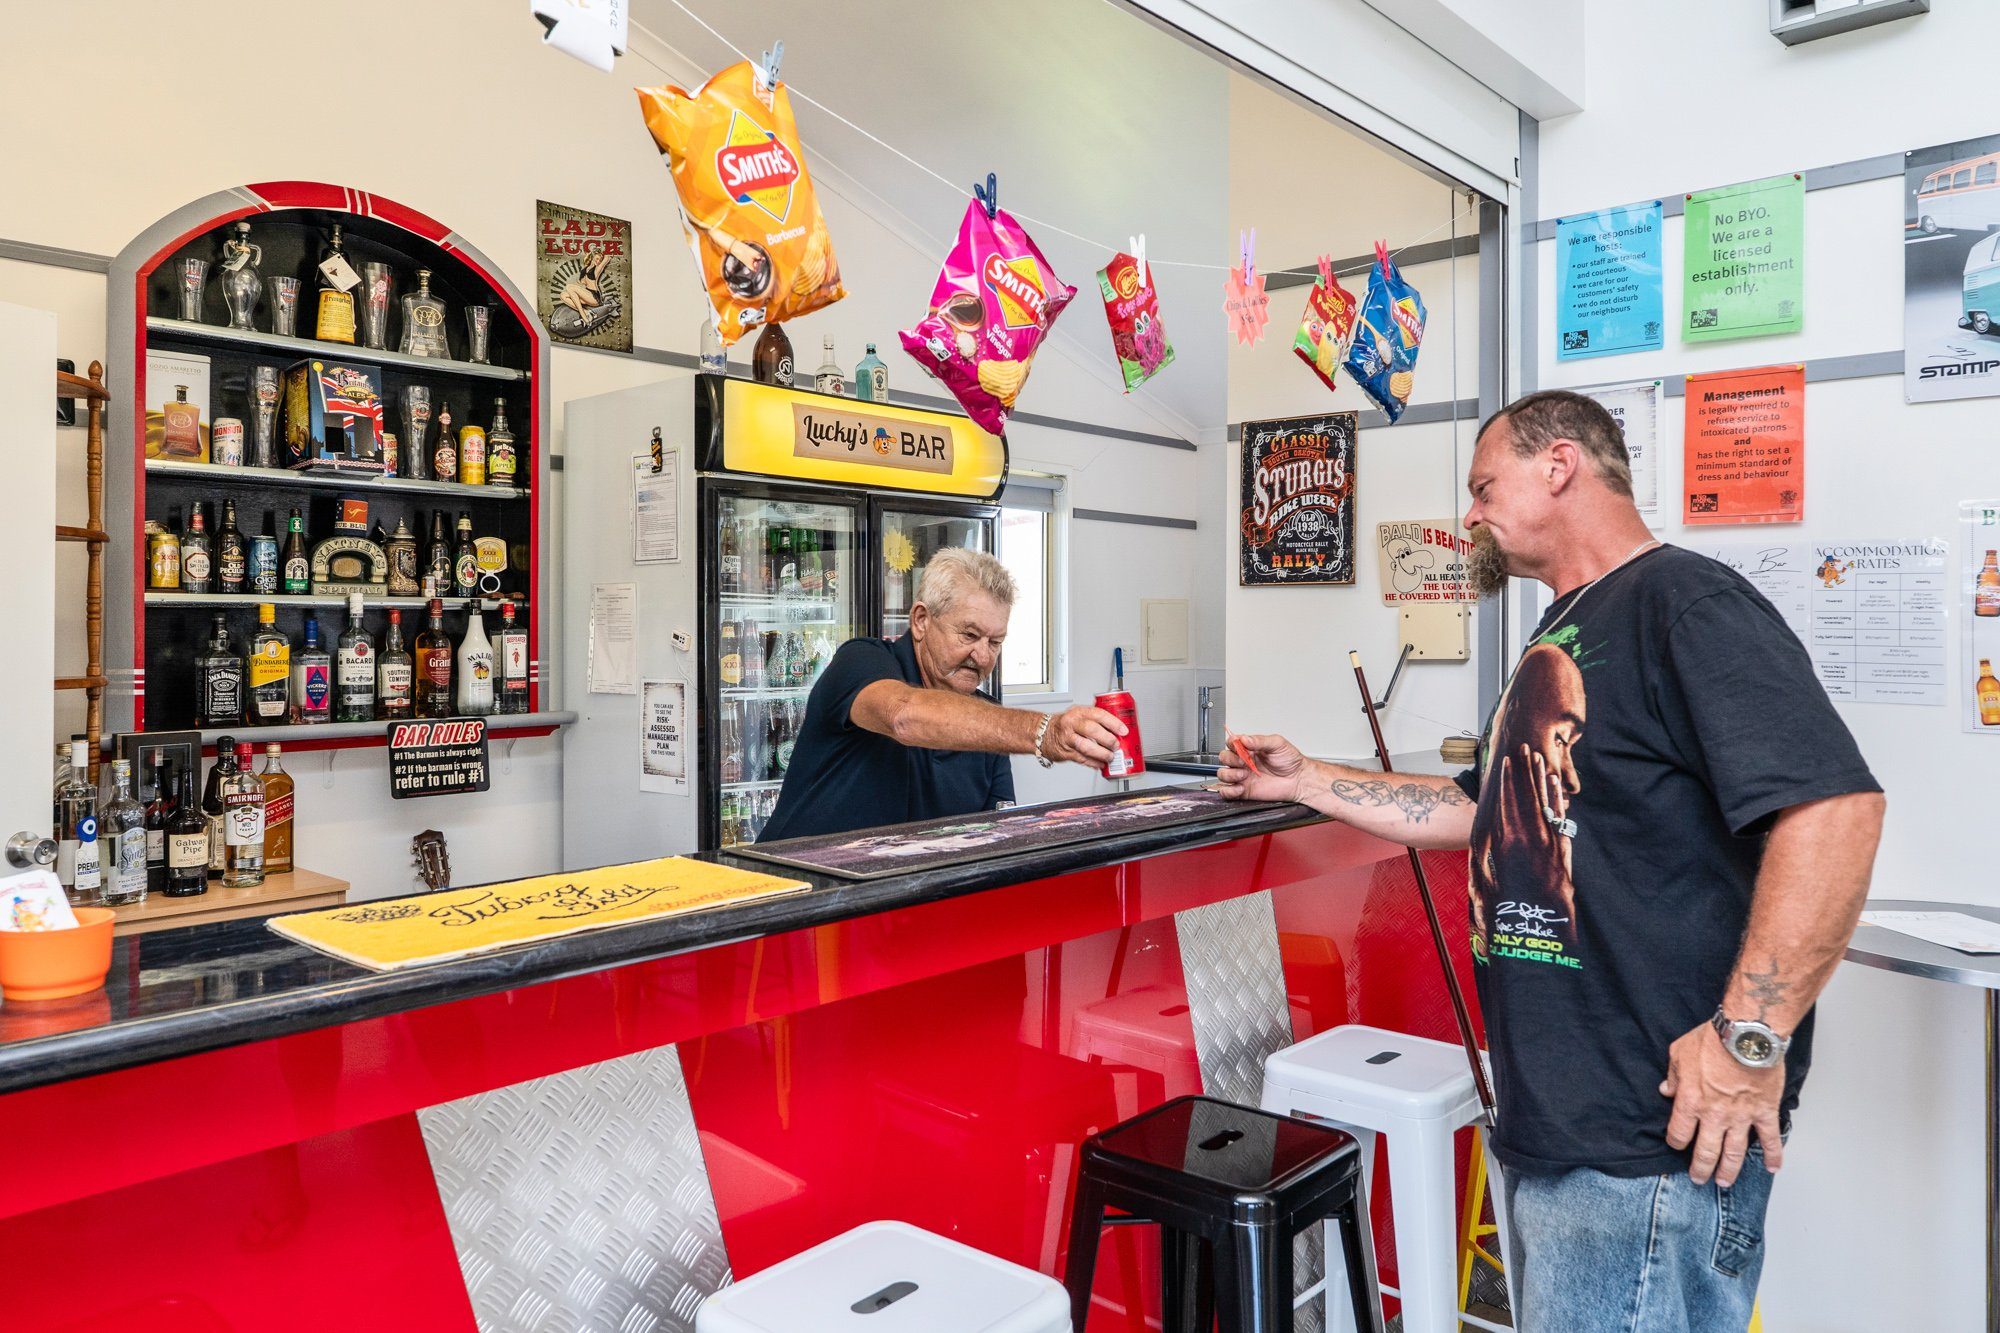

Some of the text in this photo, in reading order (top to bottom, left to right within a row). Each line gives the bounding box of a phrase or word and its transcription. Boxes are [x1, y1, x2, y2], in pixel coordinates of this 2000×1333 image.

[1715, 206, 1770, 226] No BYO.
[541, 218, 625, 239] LADY
[765, 225, 806, 246] Barbecue
[1568, 224, 1652, 246] We are responsible
[1712, 226, 1773, 244] We are a
[544, 238, 624, 256] LUCK
[1595, 241, 1623, 253] hosts:
[1713, 242, 1772, 262] licensed
[1577, 252, 1647, 269] our staff are trained
[1577, 266, 1627, 279] and courteous
[1692, 257, 1794, 283] establishment
[1588, 280, 1603, 288] care
[1604, 277, 1615, 285] for
[1616, 276, 1629, 284] our
[1725, 281, 1759, 296] only.
[1617, 284, 1639, 295] safety
[1589, 299, 1598, 307] do
[1599, 298, 1611, 306] not
[1612, 294, 1638, 304] disturb
[1591, 305, 1631, 317] neighbours
[992, 323, 1008, 340] Salt
[986, 328, 1011, 358] Vinegar
[347, 391, 366, 399] ALES
[1704, 385, 1785, 402] Management
[1698, 400, 1789, 416] is legally required to
[1707, 416, 1735, 426] refuse
[1737, 414, 1769, 424] service
[1700, 423, 1787, 437] intoxicated patrons
[803, 415, 946, 461] Lucky's BAR
[1270, 434, 1329, 452] CLASSIC
[1733, 437, 1751, 446] and
[1697, 451, 1713, 460] has
[1715, 450, 1729, 458] the
[1732, 448, 1753, 458] right
[1755, 447, 1765, 456] to
[1767, 446, 1781, 455] set
[1696, 456, 1792, 471] minimum standard of
[1697, 469, 1789, 482] dress and behaviour
[1254, 459, 1345, 525] STURGIS
[1269, 494, 1338, 529] BIKE WEEK
[1301, 514, 1316, 522] OLD
[1298, 521, 1319, 532] 1938
[1380, 524, 1432, 548] BALD IS
[1815, 545, 1946, 558] ACCOMMODATION
[1271, 554, 1326, 568] RALLY
[1857, 558, 1901, 569] RATES
[318, 586, 383, 595] SPECIAL
[1423, 583, 1439, 591] THE
[1385, 593, 1440, 601] HE COVERED
[506, 636, 527, 644] BEEFEATER
[208, 673, 221, 683] JACK
[391, 721, 484, 748] BAR RULES
[651, 724, 676, 733] ASSESSED
[647, 732, 679, 742] MANAGEMENT
[656, 742, 669, 750] PLAN
[394, 747, 484, 760] #1 The Barman is always right.
[394, 761, 460, 775] #2 If the barman is
[395, 769, 485, 790] refer to rule #1
[227, 794, 264, 804] SMIRNOFF
[275, 802, 294, 812] LABEL
[175, 839, 207, 848] Galway
[183, 846, 202, 855] Pipe
[428, 884, 592, 927] Tuborg
[1525, 938, 1563, 952] GOD
[1496, 946, 1583, 970] JUDGE ME.
